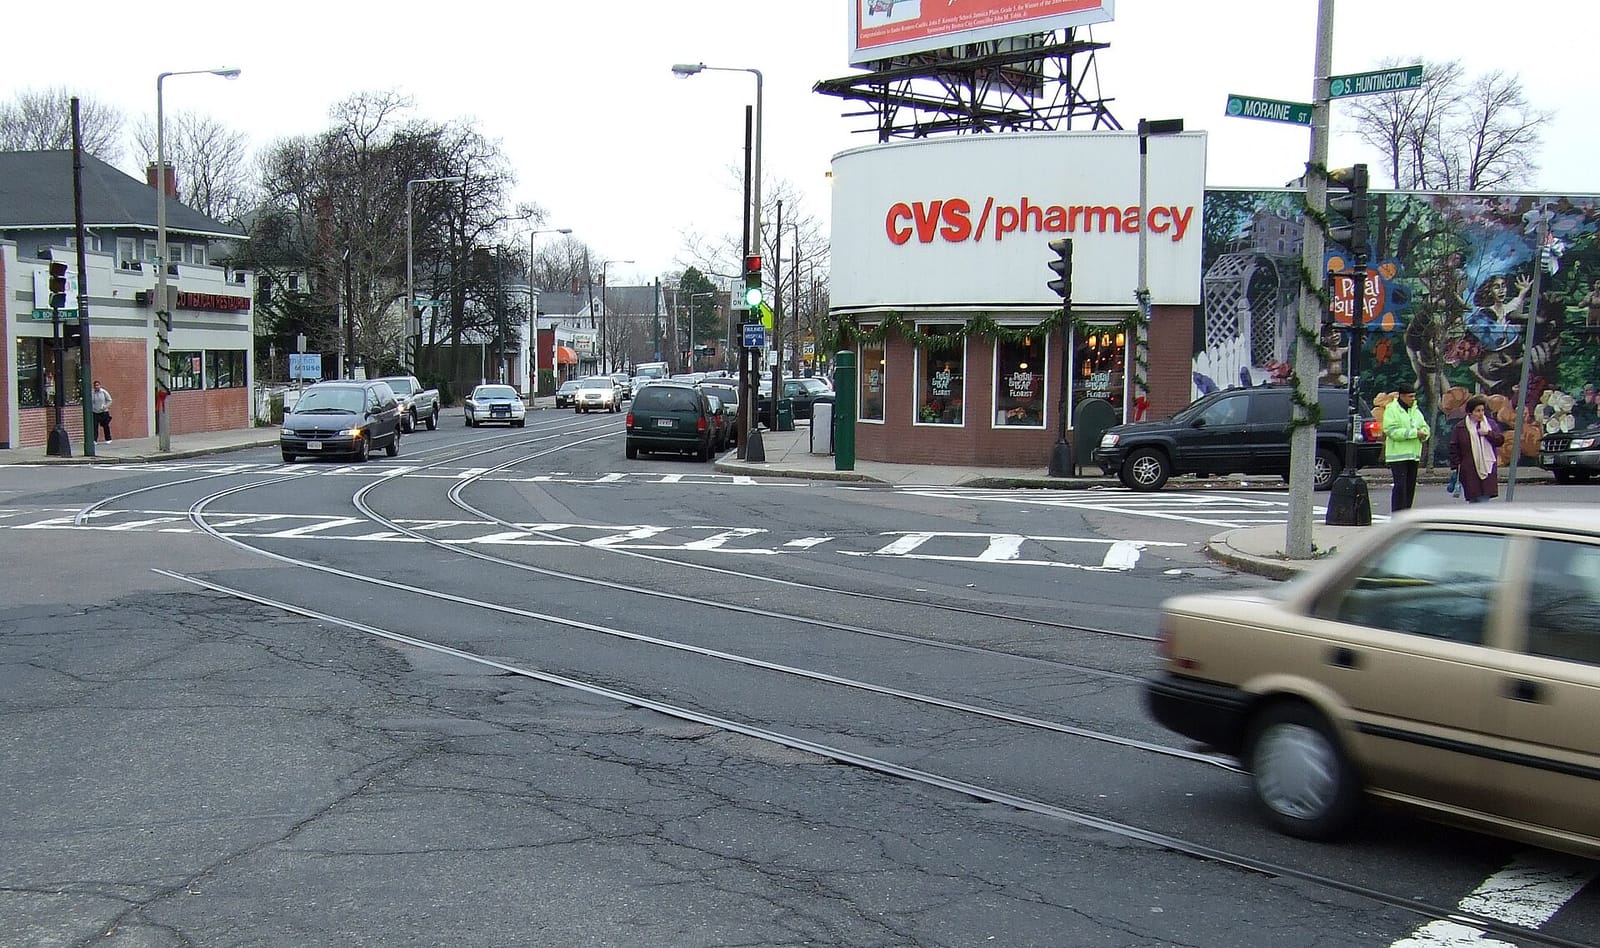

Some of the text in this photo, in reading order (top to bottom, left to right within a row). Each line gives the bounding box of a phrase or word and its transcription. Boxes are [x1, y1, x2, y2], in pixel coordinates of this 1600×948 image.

[1345, 71, 1422, 94] S. HUNTINGTON AVE
[1244, 100, 1307, 122] MORAINE ST
[886, 197, 1194, 246] CVS/pharmacy
